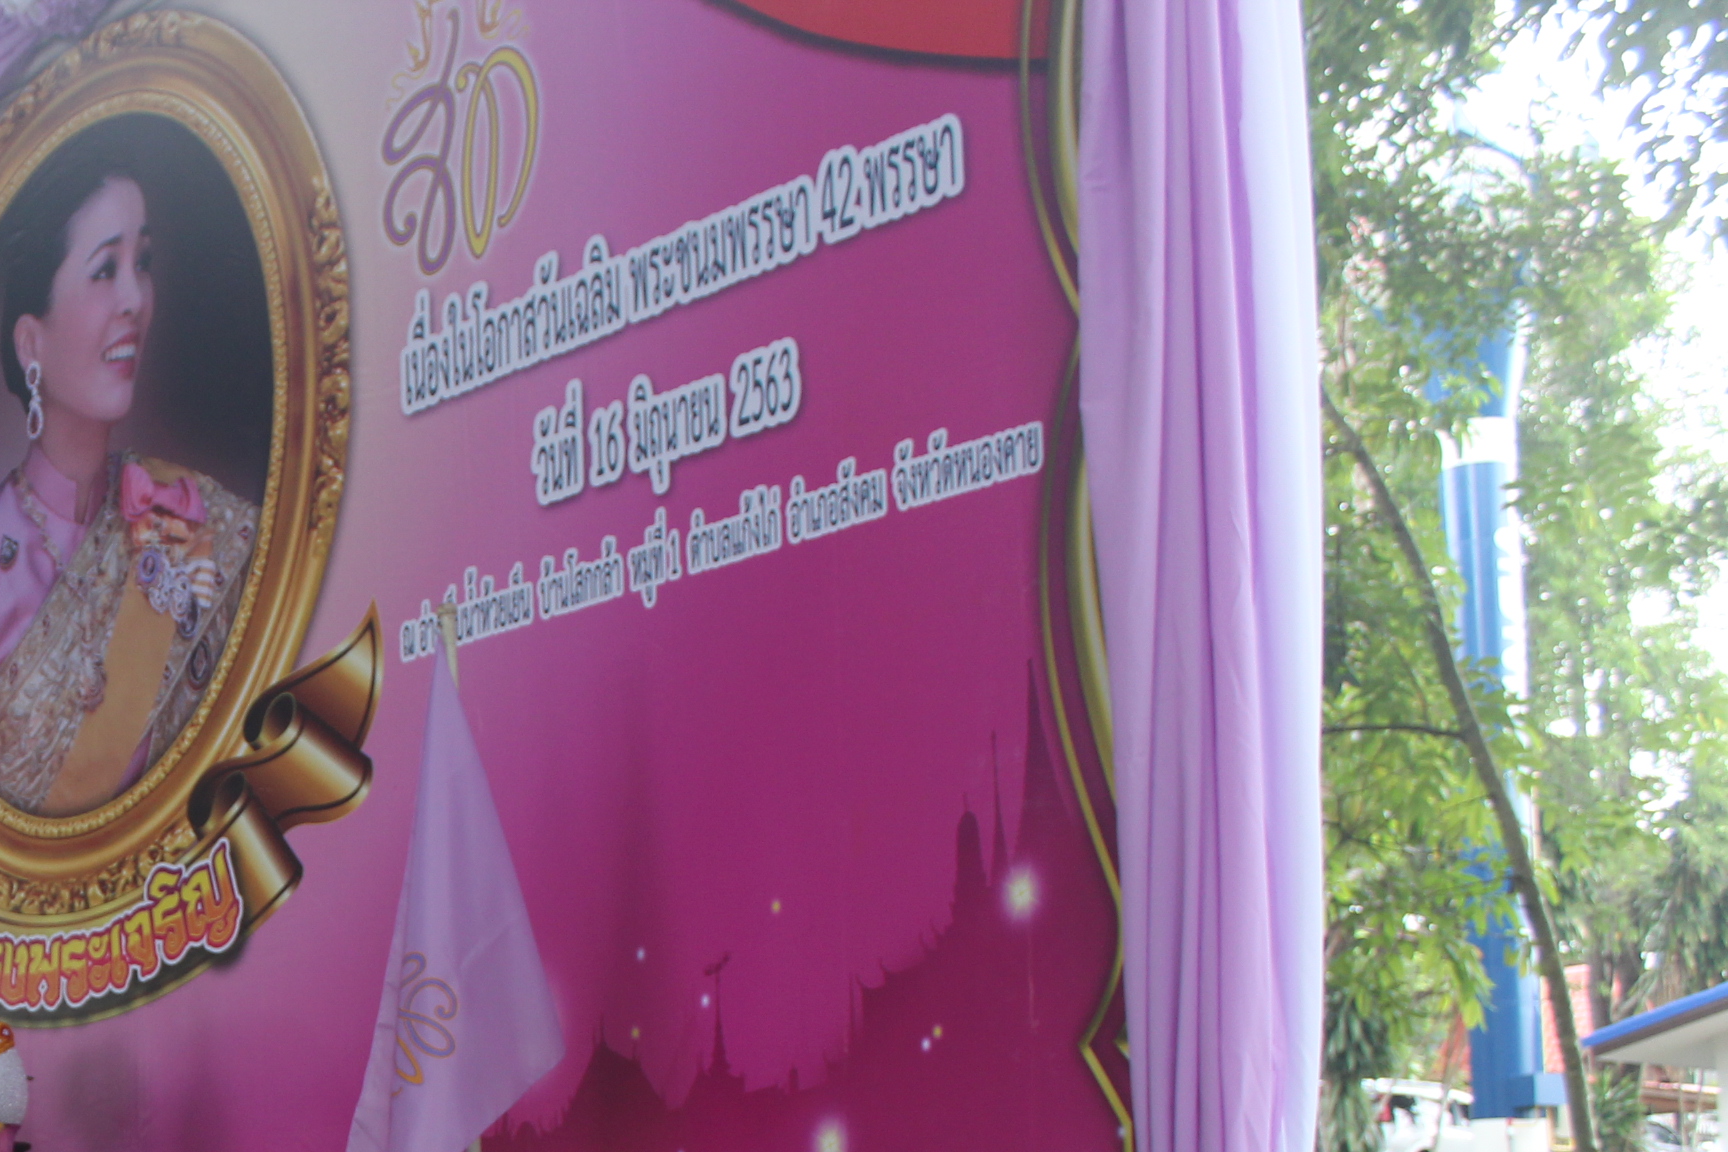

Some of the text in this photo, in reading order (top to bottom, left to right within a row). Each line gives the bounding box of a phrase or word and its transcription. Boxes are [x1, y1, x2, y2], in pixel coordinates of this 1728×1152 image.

[403, 121, 960, 408] เนื่องในโอกาสวันเฉลิม พระชนมพรรษา 42 พรรษา
[535, 344, 796, 498] วันที่ 16 มิถุนายน 2563
[402, 623, 416, 658] ณ
[630, 511, 666, 603] หมู่ที่
[669, 533, 681, 577] 1
[688, 487, 781, 571] ตำบลแก้งไก่
[788, 459, 886, 540] อำเภอสังคม
[893, 428, 1041, 507] จังหวัดหนองคาย
